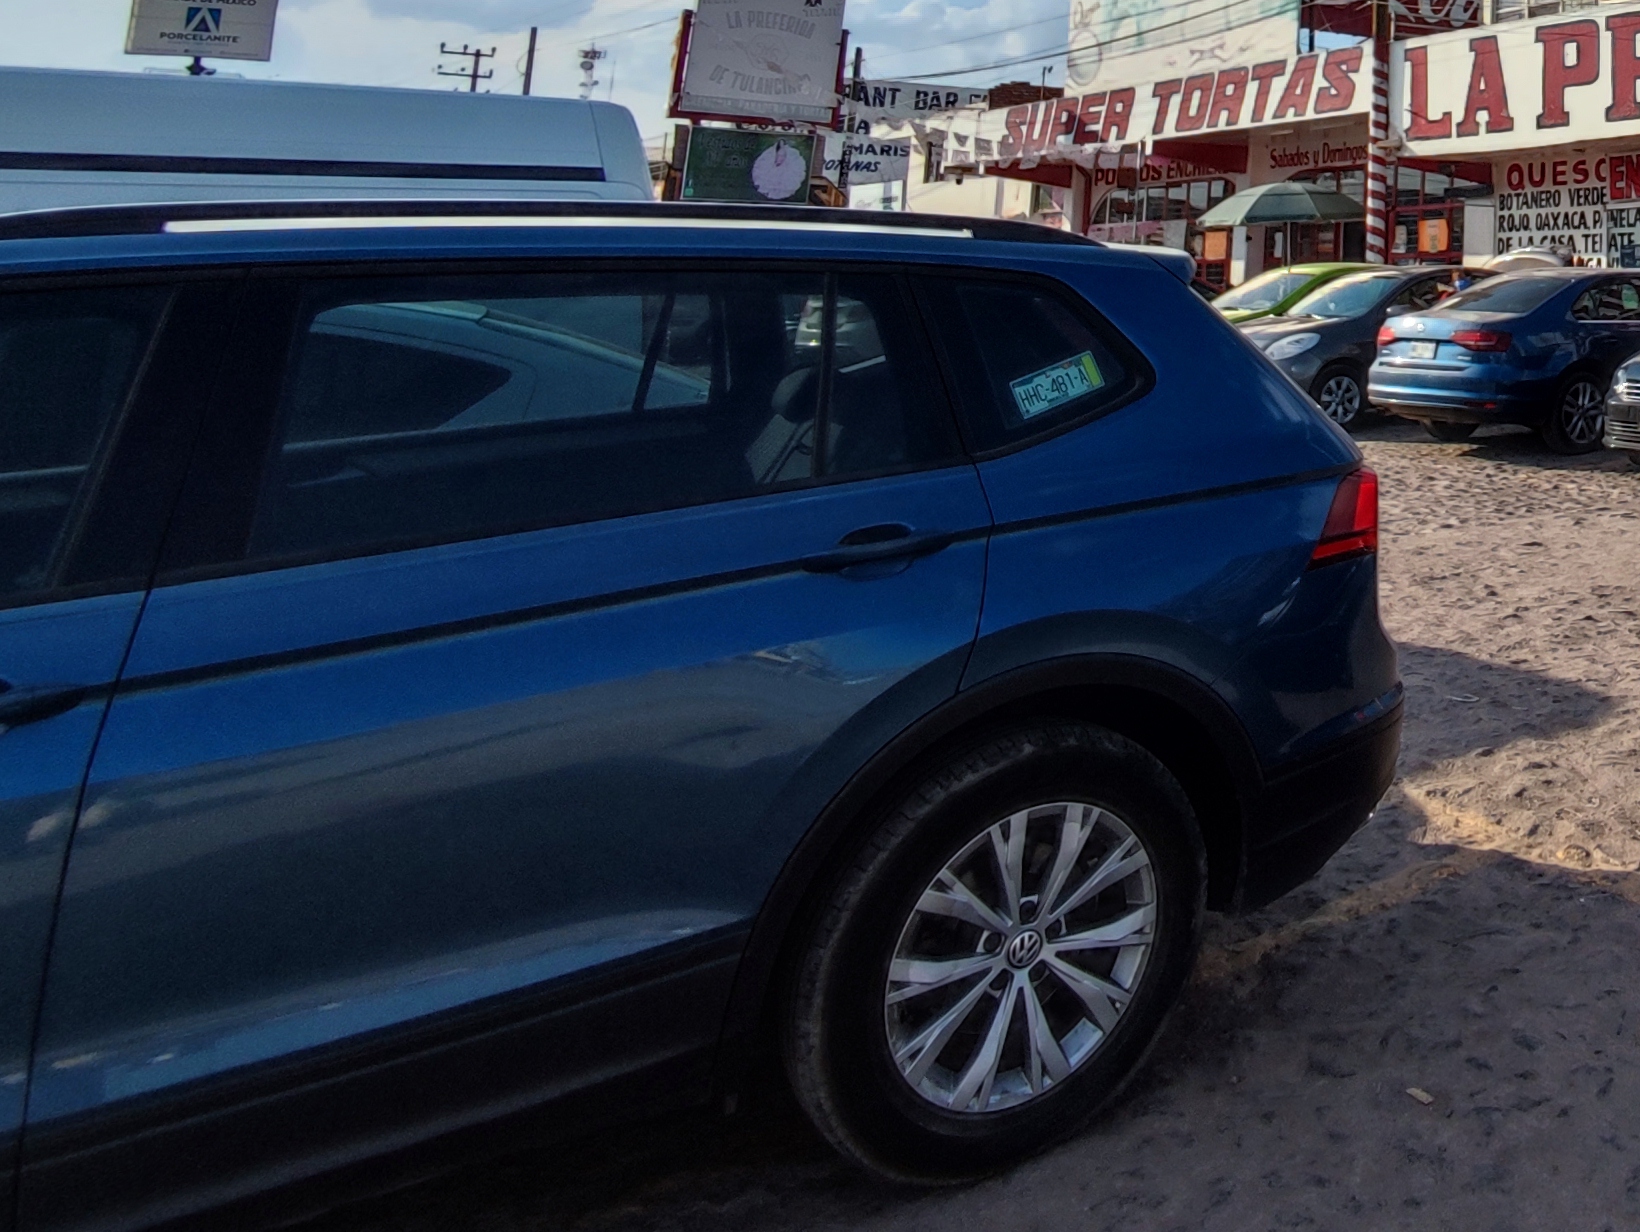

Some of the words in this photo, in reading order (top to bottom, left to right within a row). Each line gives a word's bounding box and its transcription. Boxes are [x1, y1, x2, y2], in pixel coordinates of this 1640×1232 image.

[159, 32, 239, 43] PORCELANITE
[914, 90, 958, 111] BAR
[1002, 87, 1136, 159] SUPER
[1153, 46, 1365, 136] TORTAS
[1404, 35, 1514, 142] LA
[1499, 189, 1561, 211] BOTANERO
[1568, 186, 1608, 207] VERDE
[1018, 368, 1089, 409] HHC-481-A
